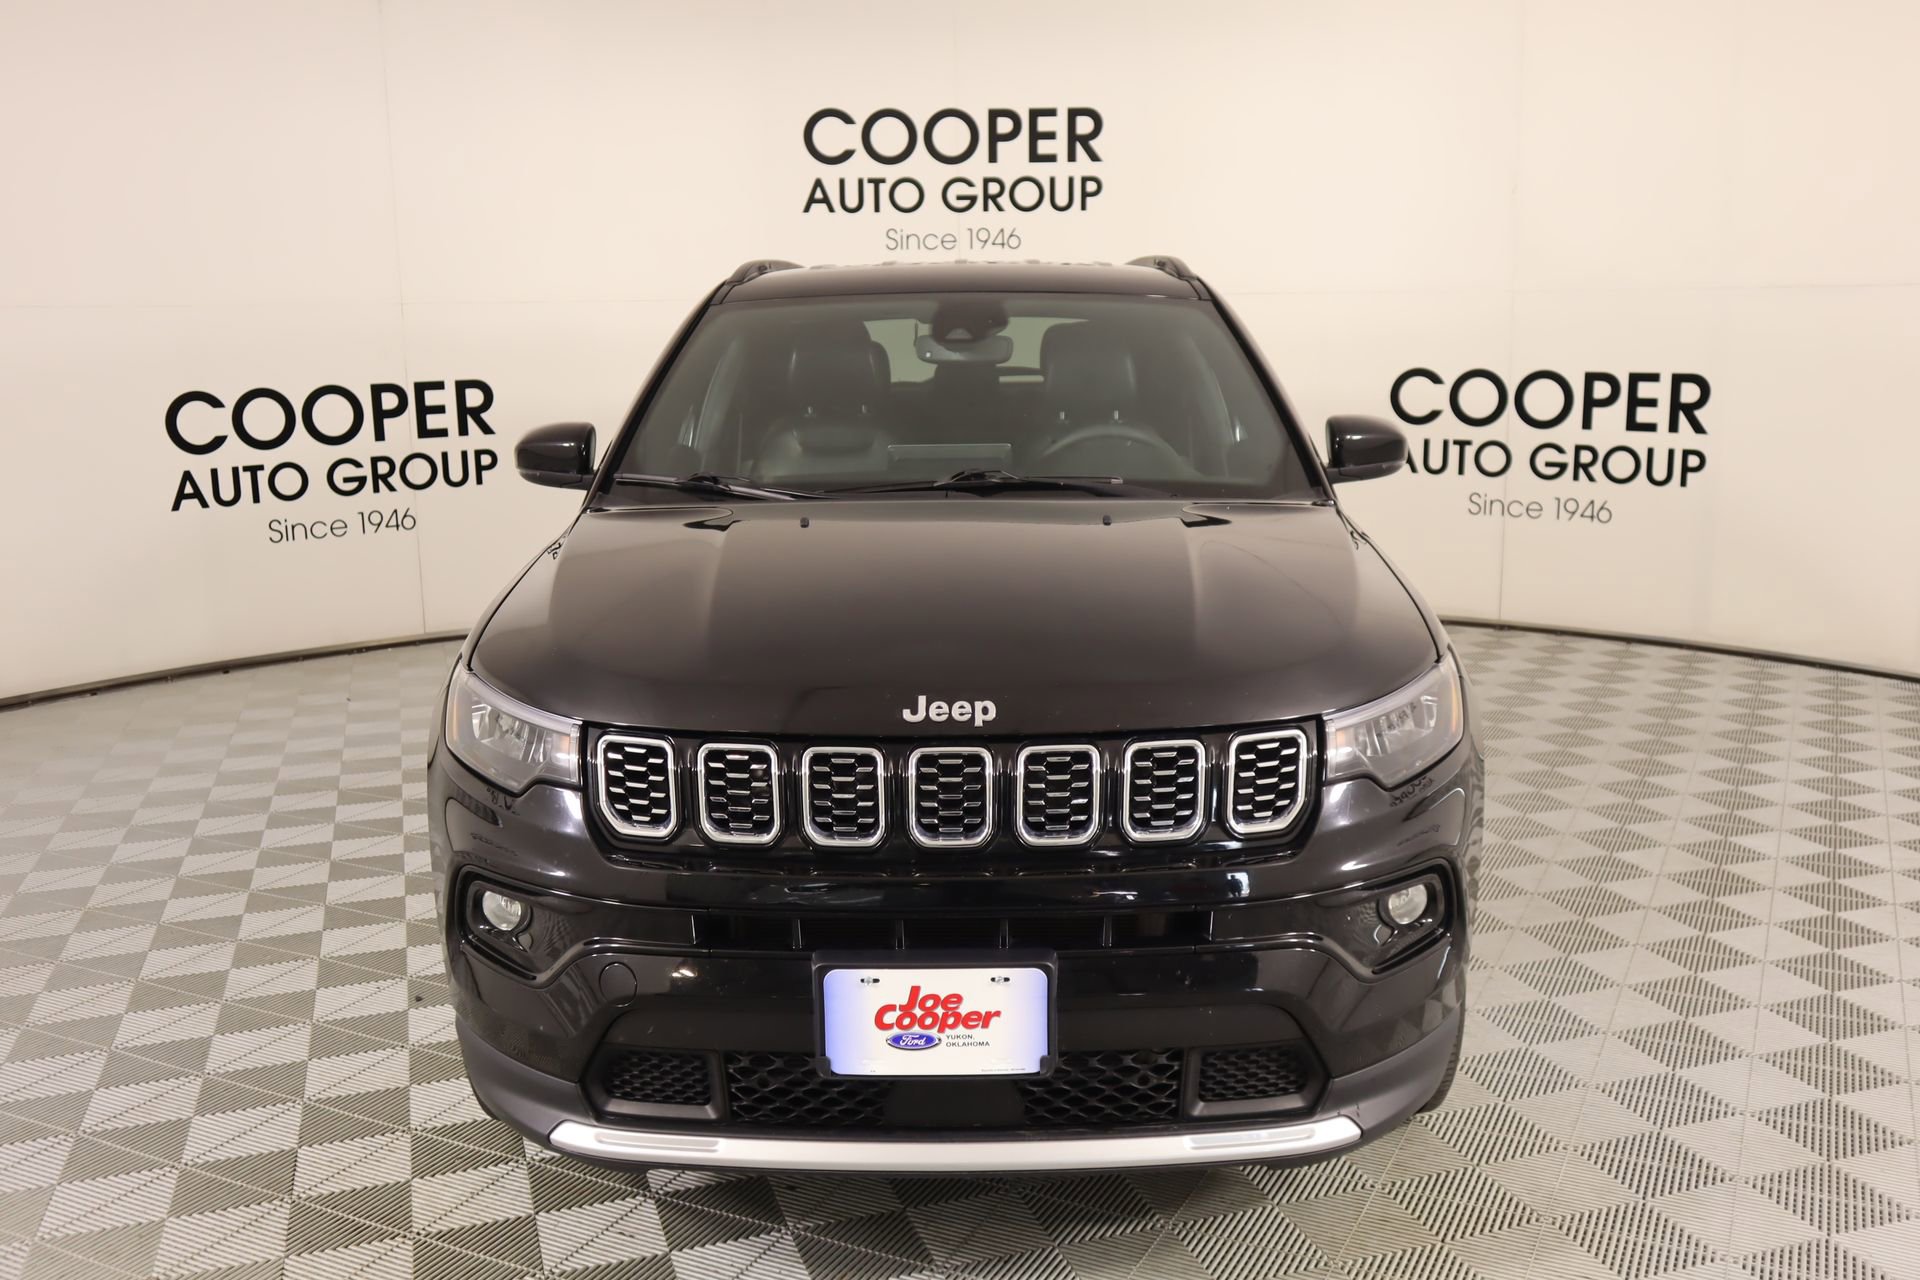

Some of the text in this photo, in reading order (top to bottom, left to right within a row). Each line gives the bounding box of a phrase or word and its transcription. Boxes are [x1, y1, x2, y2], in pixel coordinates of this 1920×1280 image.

[803, 107, 1104, 165] COOPER
[803, 176, 1103, 213] AUTO GROUP
[885, 227, 1021, 251] Since 1946
[165, 379, 496, 455] COOPER
[1390, 367, 1711, 435] COOPER
[171, 448, 498, 512] AUTO GROUP
[1529, 442, 1707, 488] GROUP
[268, 507, 417, 543] Since 1946
[1467, 491, 1613, 524] Since 1946
[902, 695, 997, 727] Jeep
[899, 986, 963, 1012] Joe
[874, 1004, 1001, 1034] Cooper
[900, 1034, 926, 1046] Ford
